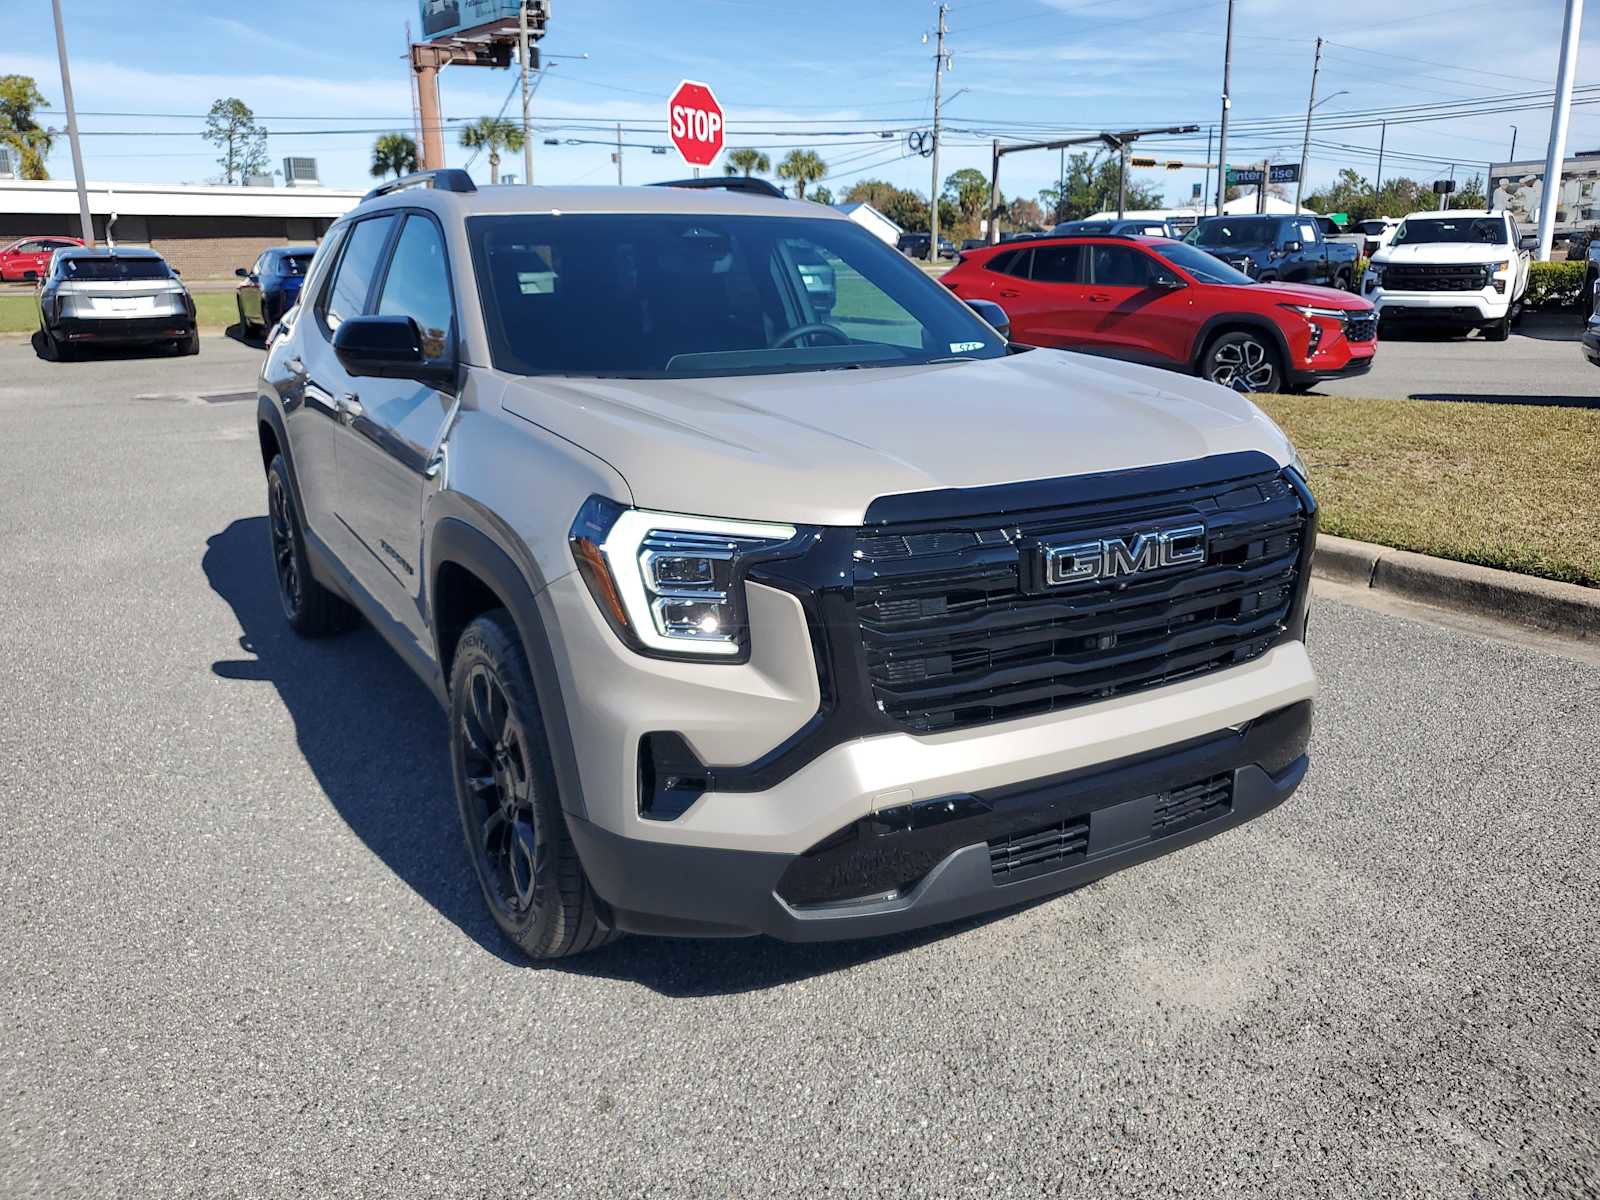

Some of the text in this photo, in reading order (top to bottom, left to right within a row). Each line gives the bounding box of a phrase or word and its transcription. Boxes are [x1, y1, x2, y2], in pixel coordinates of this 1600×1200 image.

[672, 105, 721, 143] STOP
[1227, 167, 1294, 181] enterrise
[1046, 525, 1204, 585] GMC
